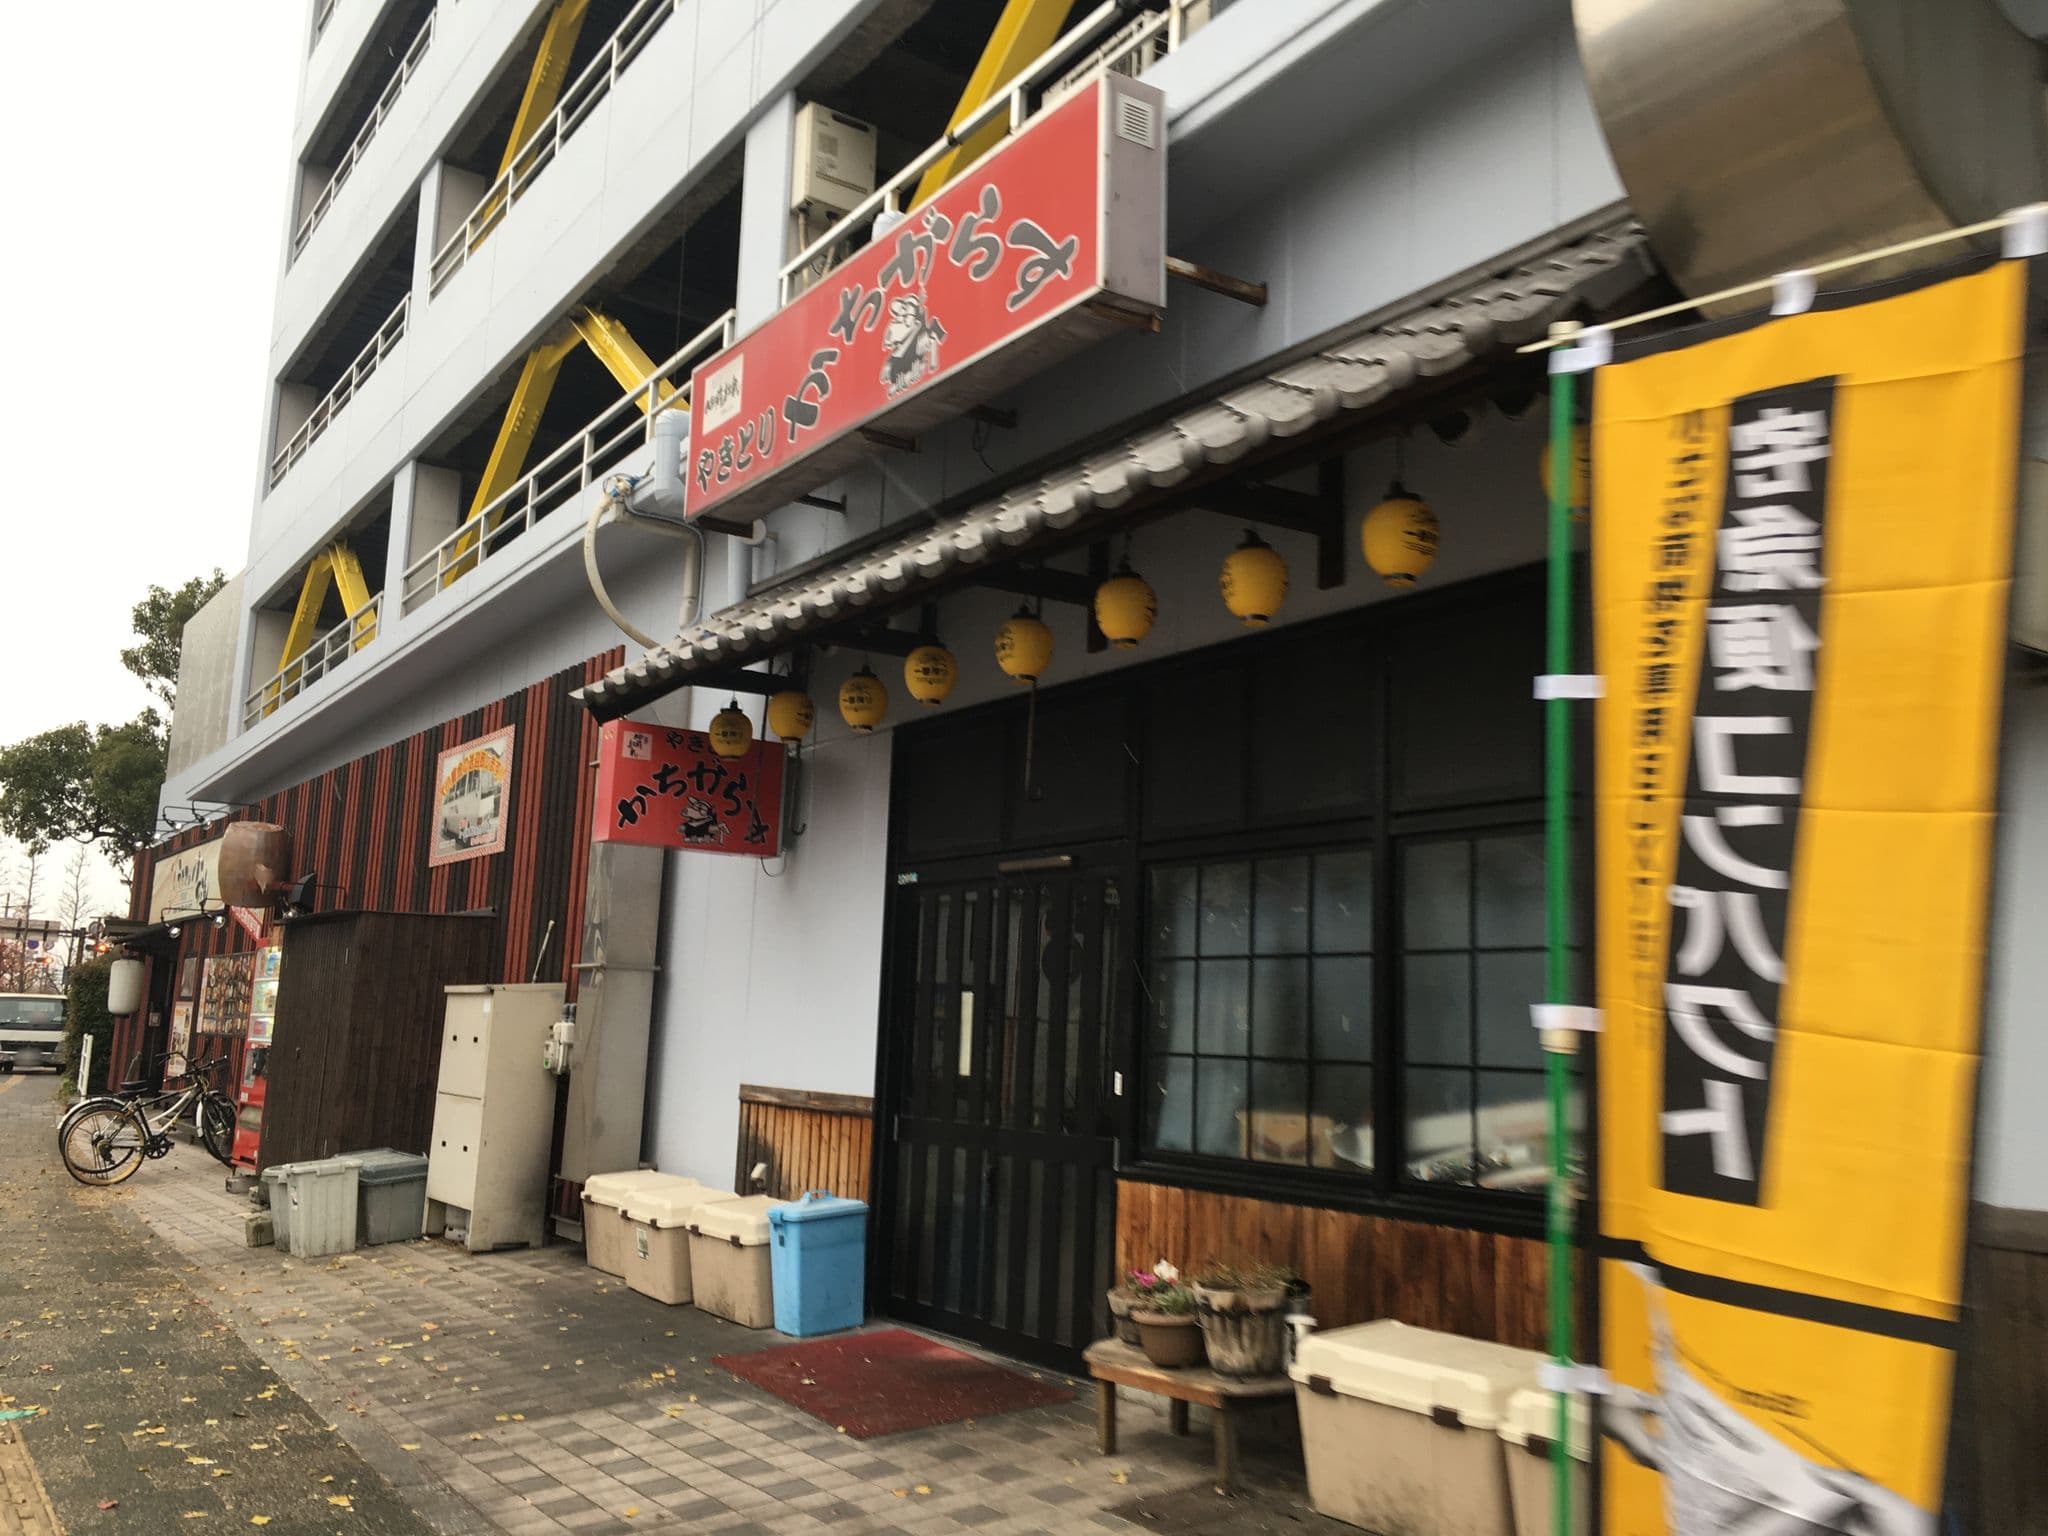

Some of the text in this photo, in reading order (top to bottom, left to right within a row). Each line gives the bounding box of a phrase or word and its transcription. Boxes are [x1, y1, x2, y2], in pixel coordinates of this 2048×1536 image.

[783, 183, 1079, 443] かちがらす
[696, 405, 777, 495] やきとり
[617, 758, 769, 844] かちがらす
